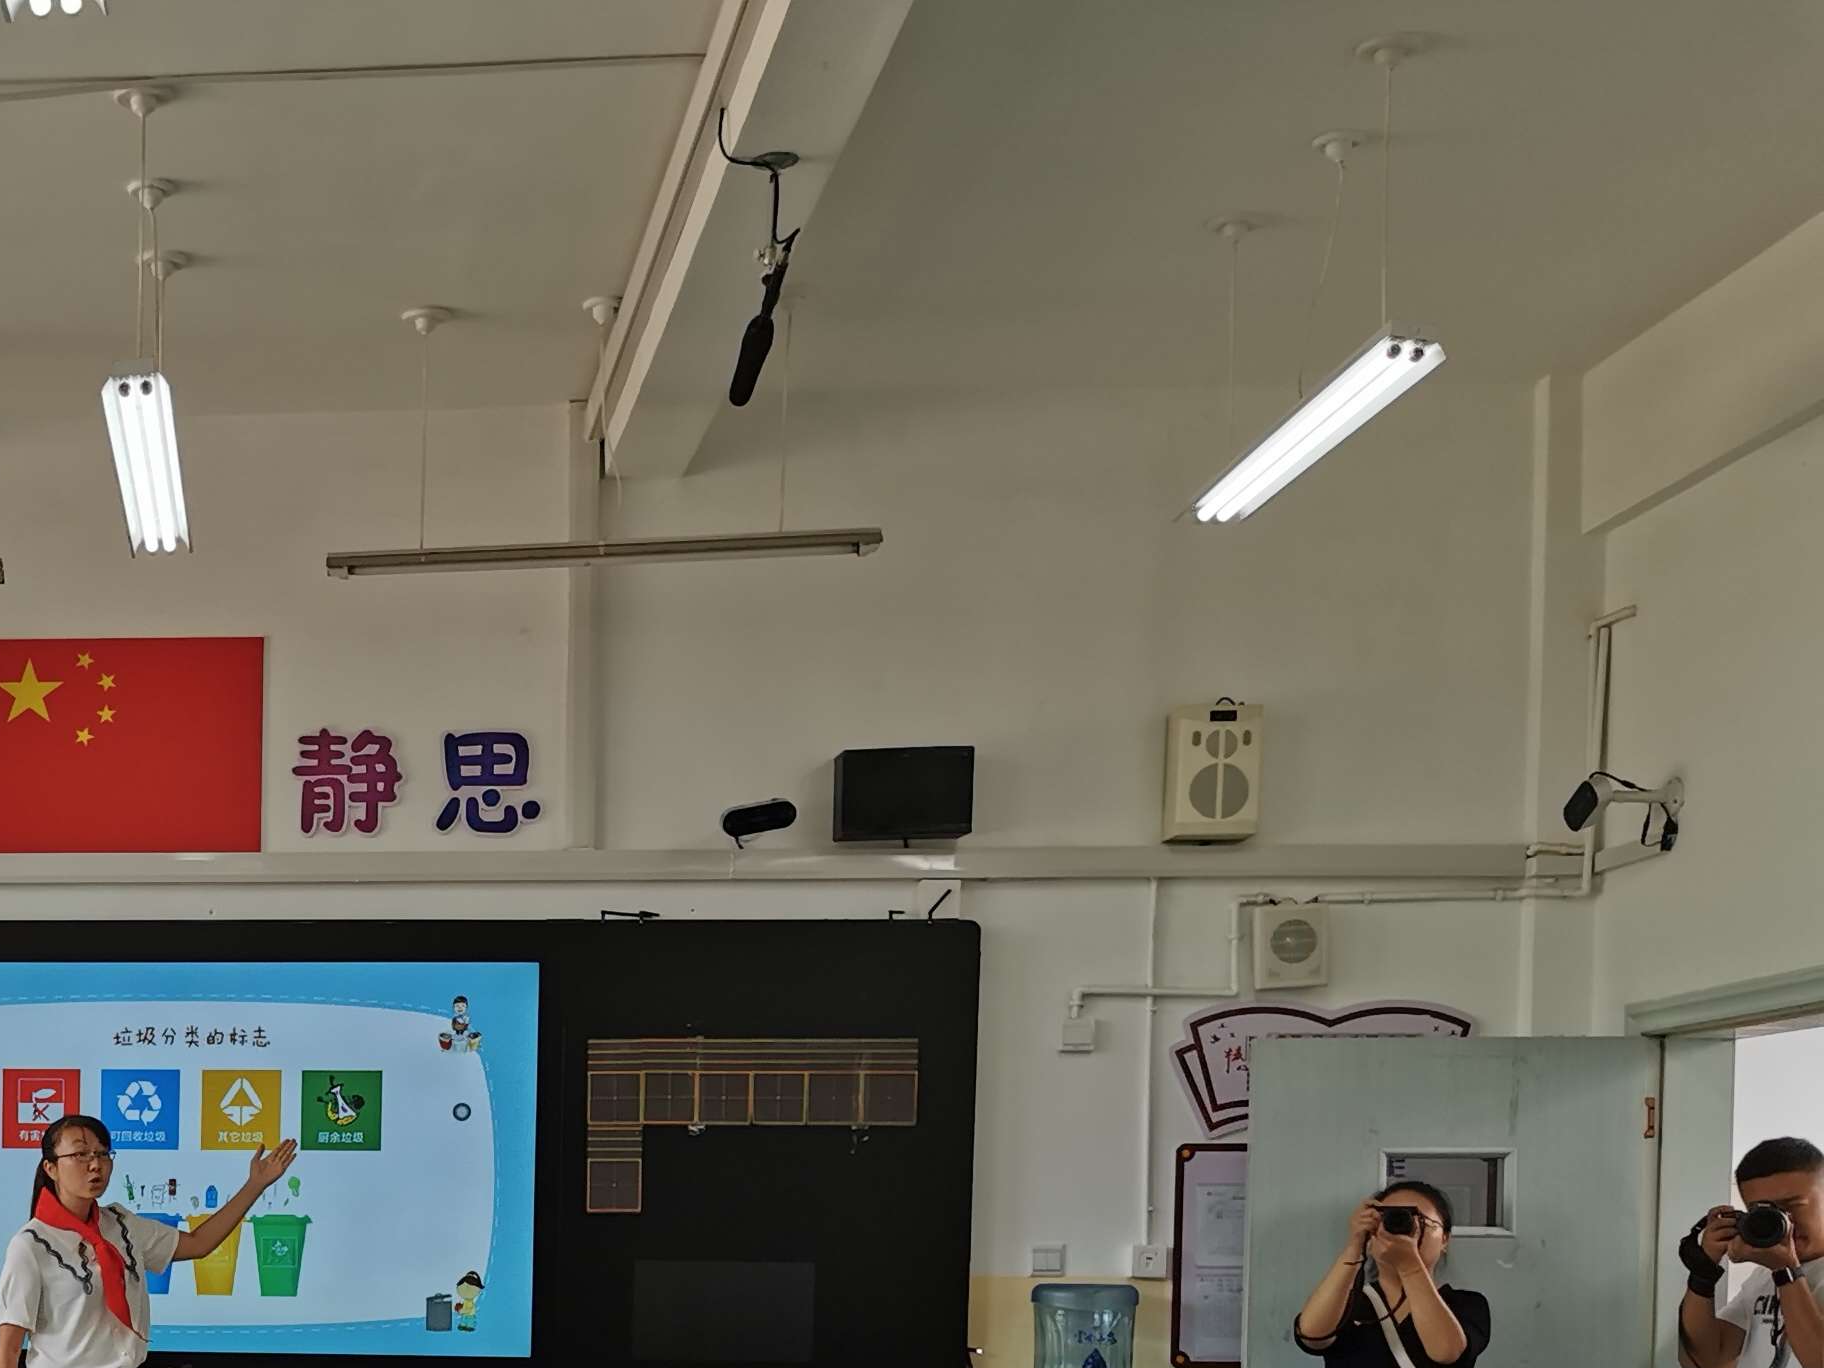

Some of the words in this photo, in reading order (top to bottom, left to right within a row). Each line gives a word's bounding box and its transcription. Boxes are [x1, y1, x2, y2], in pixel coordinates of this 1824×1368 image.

[292, 727, 542, 836] 静思
[113, 1026, 271, 1048] 垃圾分类的标志
[111, 1130, 166, 1142] 可回收垃圾
[317, 1131, 364, 1143] 厨余垃圾
